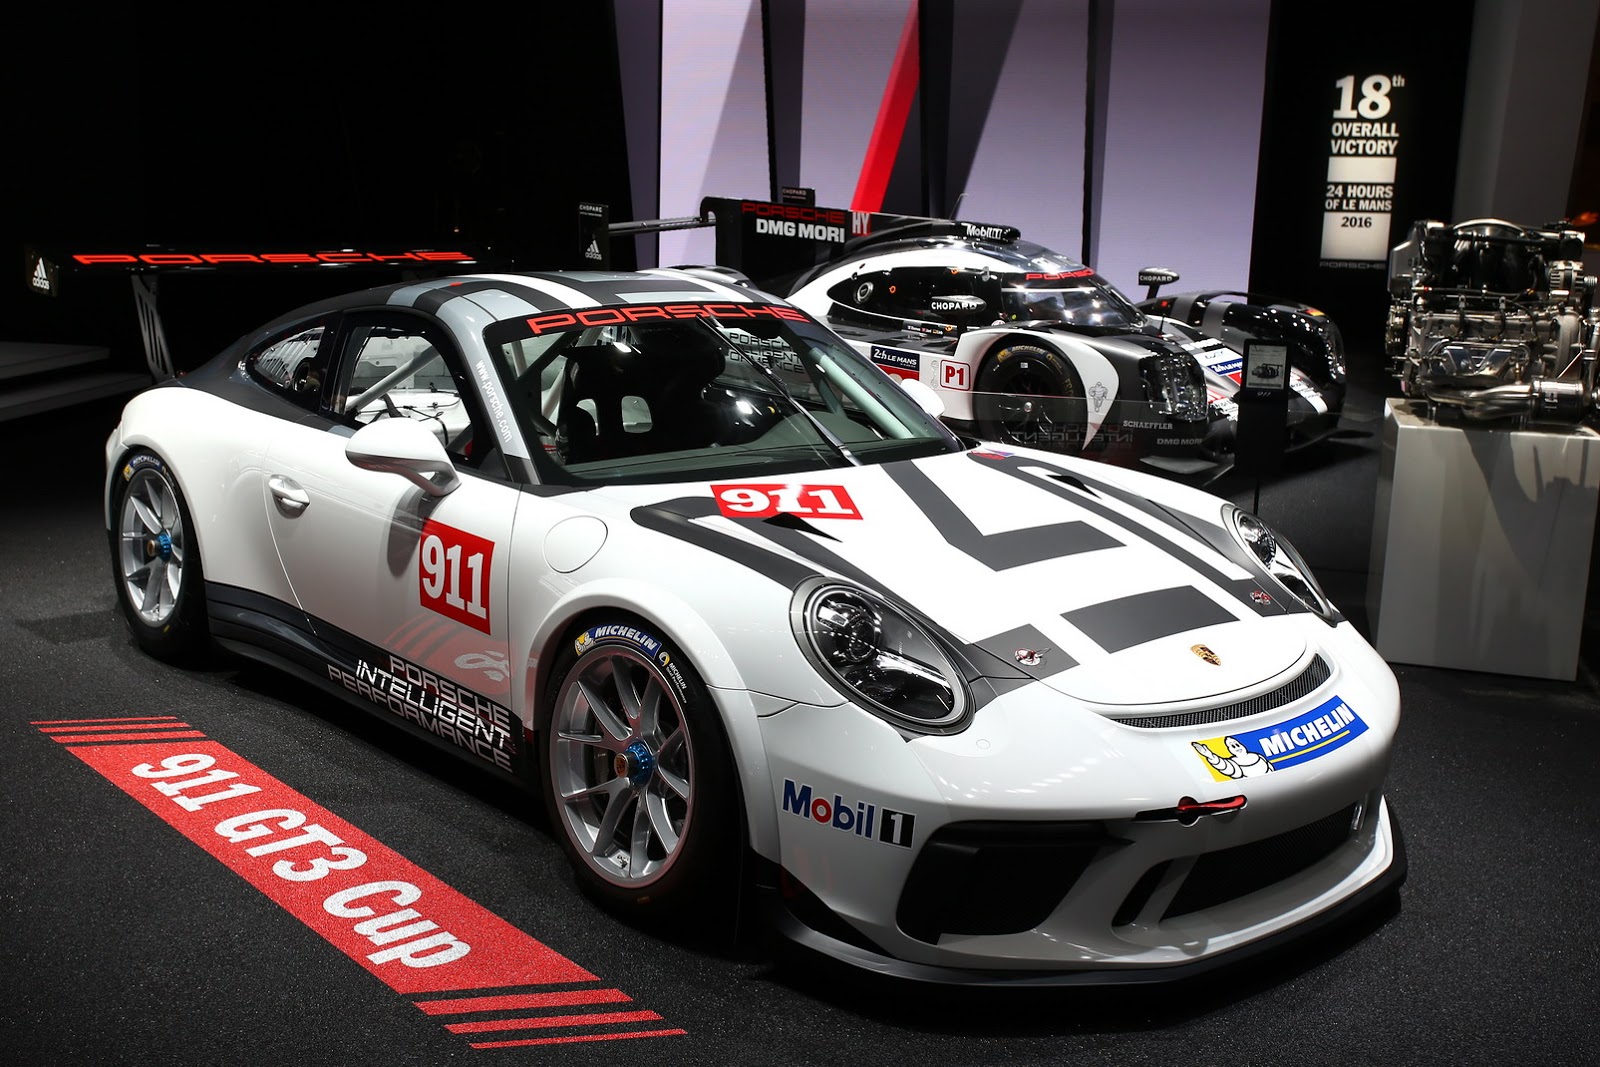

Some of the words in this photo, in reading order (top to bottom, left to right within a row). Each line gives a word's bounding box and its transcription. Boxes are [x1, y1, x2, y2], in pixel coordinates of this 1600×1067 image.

[1333, 74, 1405, 120] 18th
[1331, 122, 1399, 137] OVERALL
[1331, 139, 1398, 155] VICTORY
[782, 187, 807, 196] CHOPARD
[1326, 184, 1343, 197] 24
[1347, 185, 1394, 198] HOURS
[741, 202, 845, 224] PORSCHE
[1325, 199, 1340, 210] OF
[1342, 199, 1356, 210] LE
[1359, 200, 1392, 211] MANS
[756, 218, 796, 237] DMG
[798, 223, 845, 243] MORI
[965, 223, 992, 239] Mobil
[1341, 216, 1372, 228] 2016
[72, 251, 474, 265] PORSCHE
[1319, 261, 1387, 270] PORSCHE
[33, 277, 50, 290] adidas
[931, 301, 977, 311] CHOPARD
[526, 304, 810, 335] PORSCHE
[896, 356, 917, 366] MANS
[945, 365, 964, 386] P1
[476, 360, 513, 443] www.porsche.com
[1123, 420, 1173, 430] SCHAEFFLER
[720, 488, 855, 515] 911
[422, 534, 487, 620] 911
[594, 625, 658, 651] MICHELIN
[669, 662, 688, 690] MICHELIN
[389, 654, 511, 731] PORSCHE
[355, 659, 511, 749] INTELLIGENT
[327, 664, 513, 773] PERFORMANCE
[1258, 703, 1356, 757] MICHELIN
[782, 778, 877, 839] Mobil
[132, 753, 262, 813] 911
[214, 808, 368, 882] GT3
[322, 880, 472, 969] Cup
